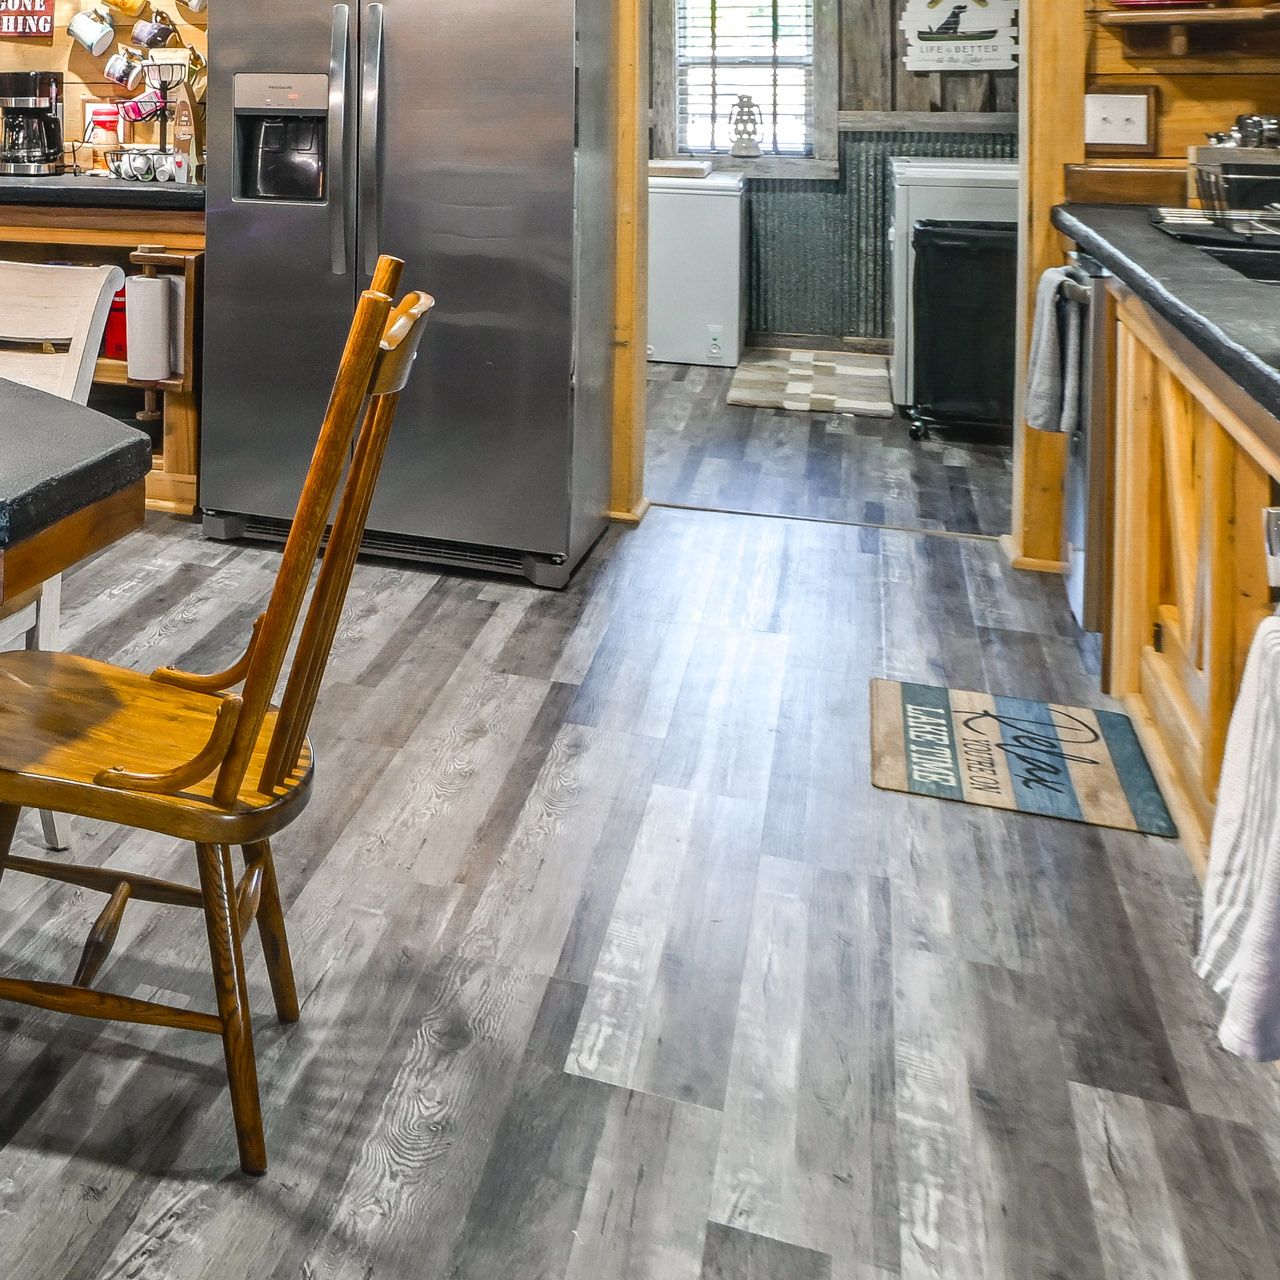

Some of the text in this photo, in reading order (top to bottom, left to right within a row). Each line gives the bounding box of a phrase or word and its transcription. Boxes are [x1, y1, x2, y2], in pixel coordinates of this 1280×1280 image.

[920, 45, 943, 53] LIFE
[954, 45, 999, 53] BETTER
[906, 704, 956, 786] LAKE TIME
[952, 708, 1100, 794] Relax
[969, 776, 1001, 795] ON
